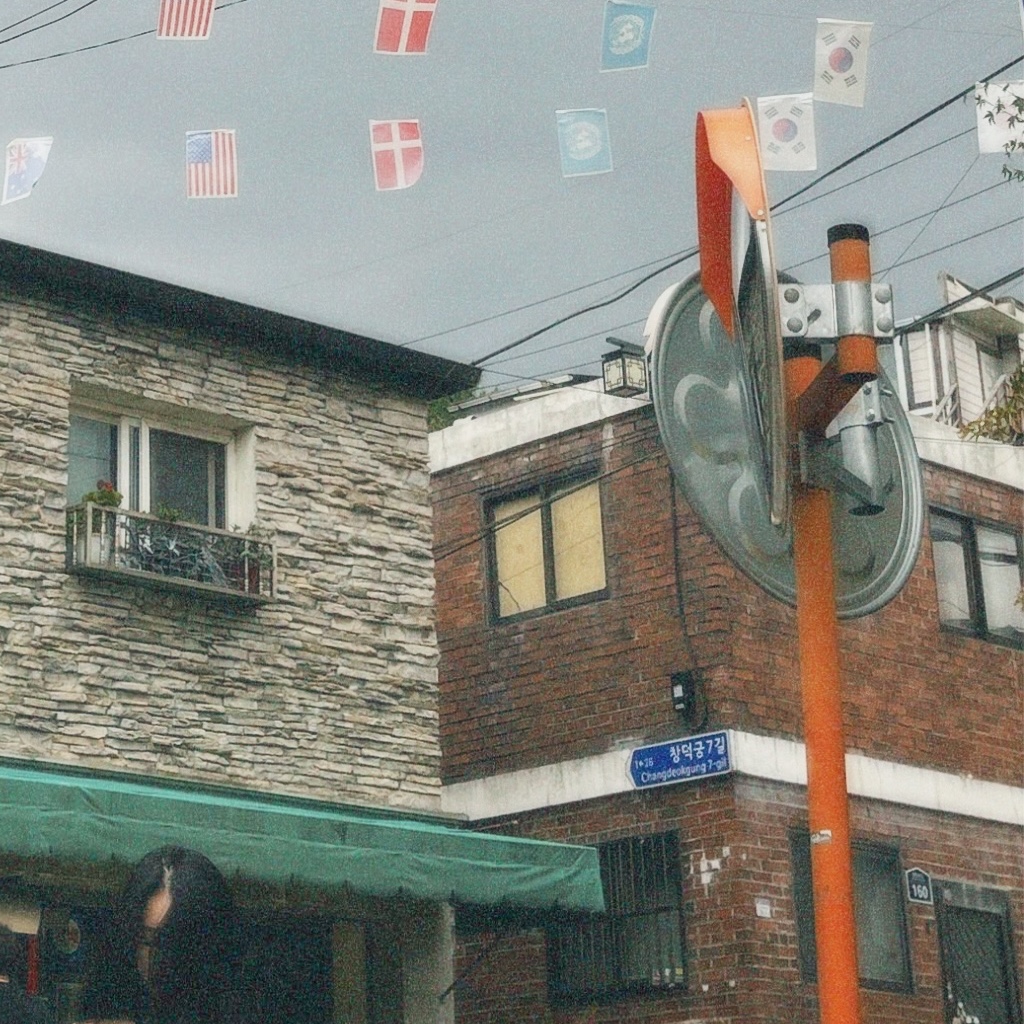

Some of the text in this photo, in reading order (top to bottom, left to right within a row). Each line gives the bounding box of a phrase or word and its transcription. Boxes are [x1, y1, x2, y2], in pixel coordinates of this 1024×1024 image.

[670, 736, 726, 763] 창덕궁7길
[641, 756, 727, 783] Changdeokgung 7-gil
[911, 884, 929, 899] 160
